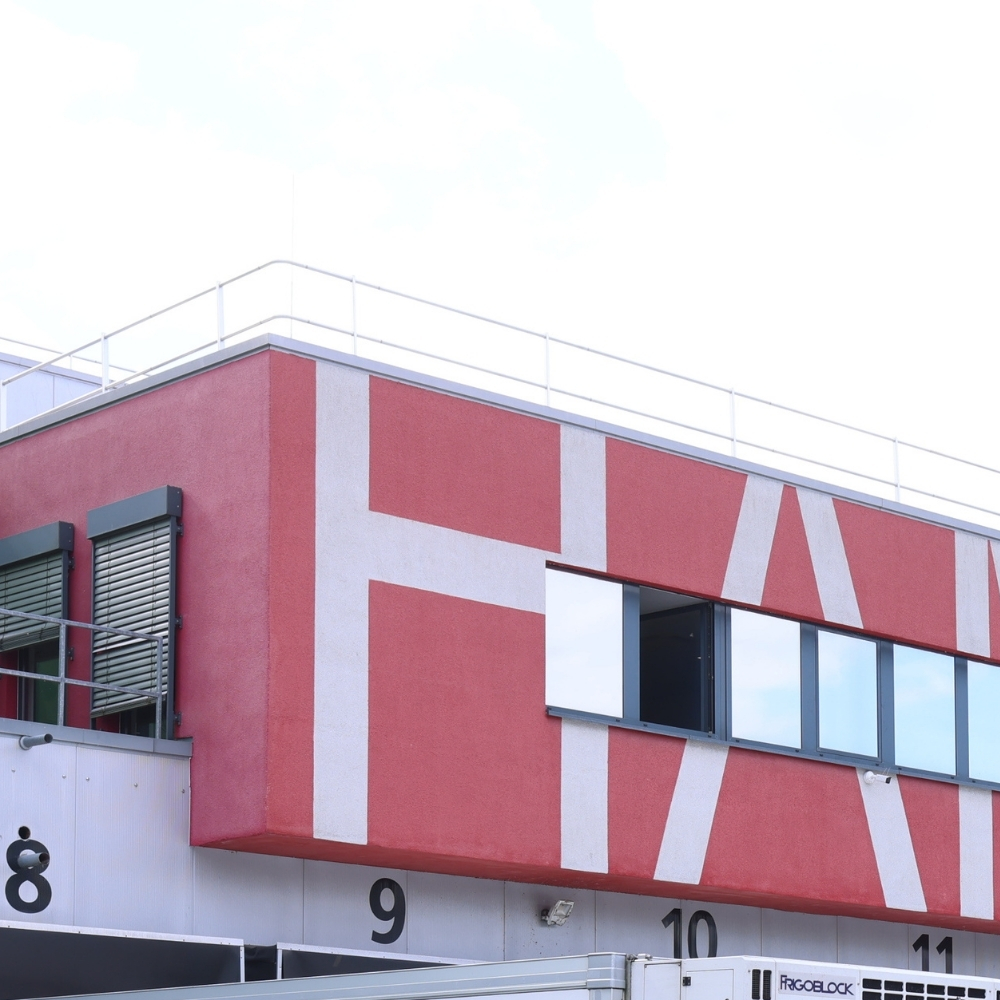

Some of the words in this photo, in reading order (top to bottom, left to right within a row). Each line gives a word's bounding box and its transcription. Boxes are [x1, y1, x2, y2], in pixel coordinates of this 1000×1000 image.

[6, 839, 52, 914] 8
[369, 877, 407, 944] 9
[661, 908, 718, 959] 10
[912, 934, 954, 975] 11
[780, 974, 855, 997] FRIGOBLOCK
